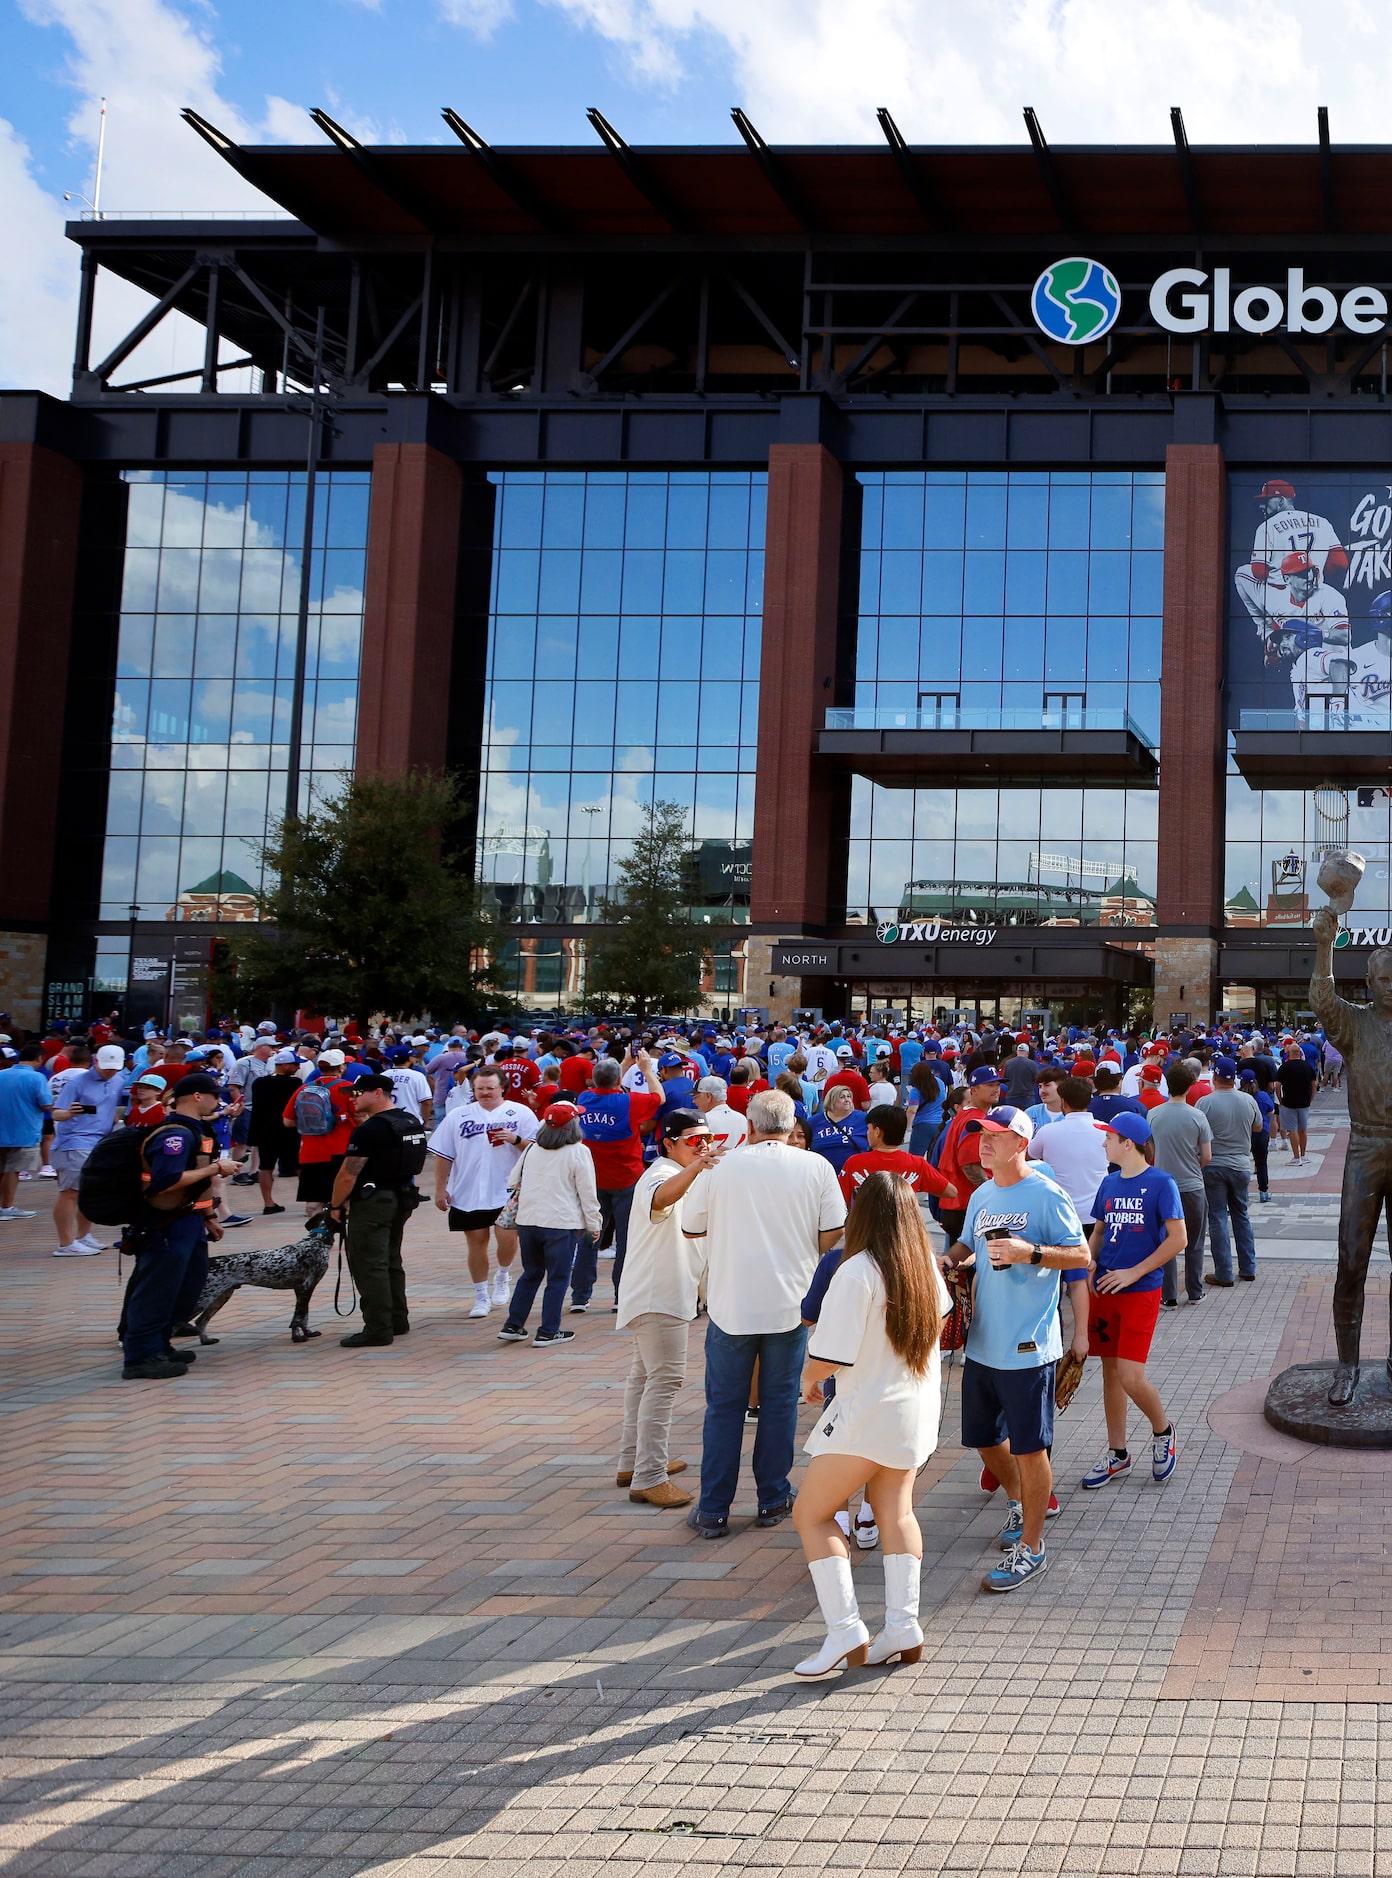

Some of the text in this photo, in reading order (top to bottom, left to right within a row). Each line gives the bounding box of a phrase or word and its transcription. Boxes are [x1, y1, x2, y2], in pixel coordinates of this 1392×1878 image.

[1149, 267, 1388, 334] Globe
[1350, 493, 1391, 538] GO
[898, 923, 996, 945] TXU energy
[1350, 928, 1391, 946] TXU
[782, 955, 827, 965] NORTH
[48, 982, 84, 993] GRAND
[48, 995, 83, 1005] SLAM
[48, 1007, 82, 1018] TEAM
[770, 1055, 780, 1066] 15
[817, 1057, 824, 1068] 6
[581, 1113, 616, 1126] TEXAS
[1114, 1198, 1143, 1210] TAKE
[974, 1208, 1028, 1239] Rangers
[1109, 1224, 1123, 1243] T
